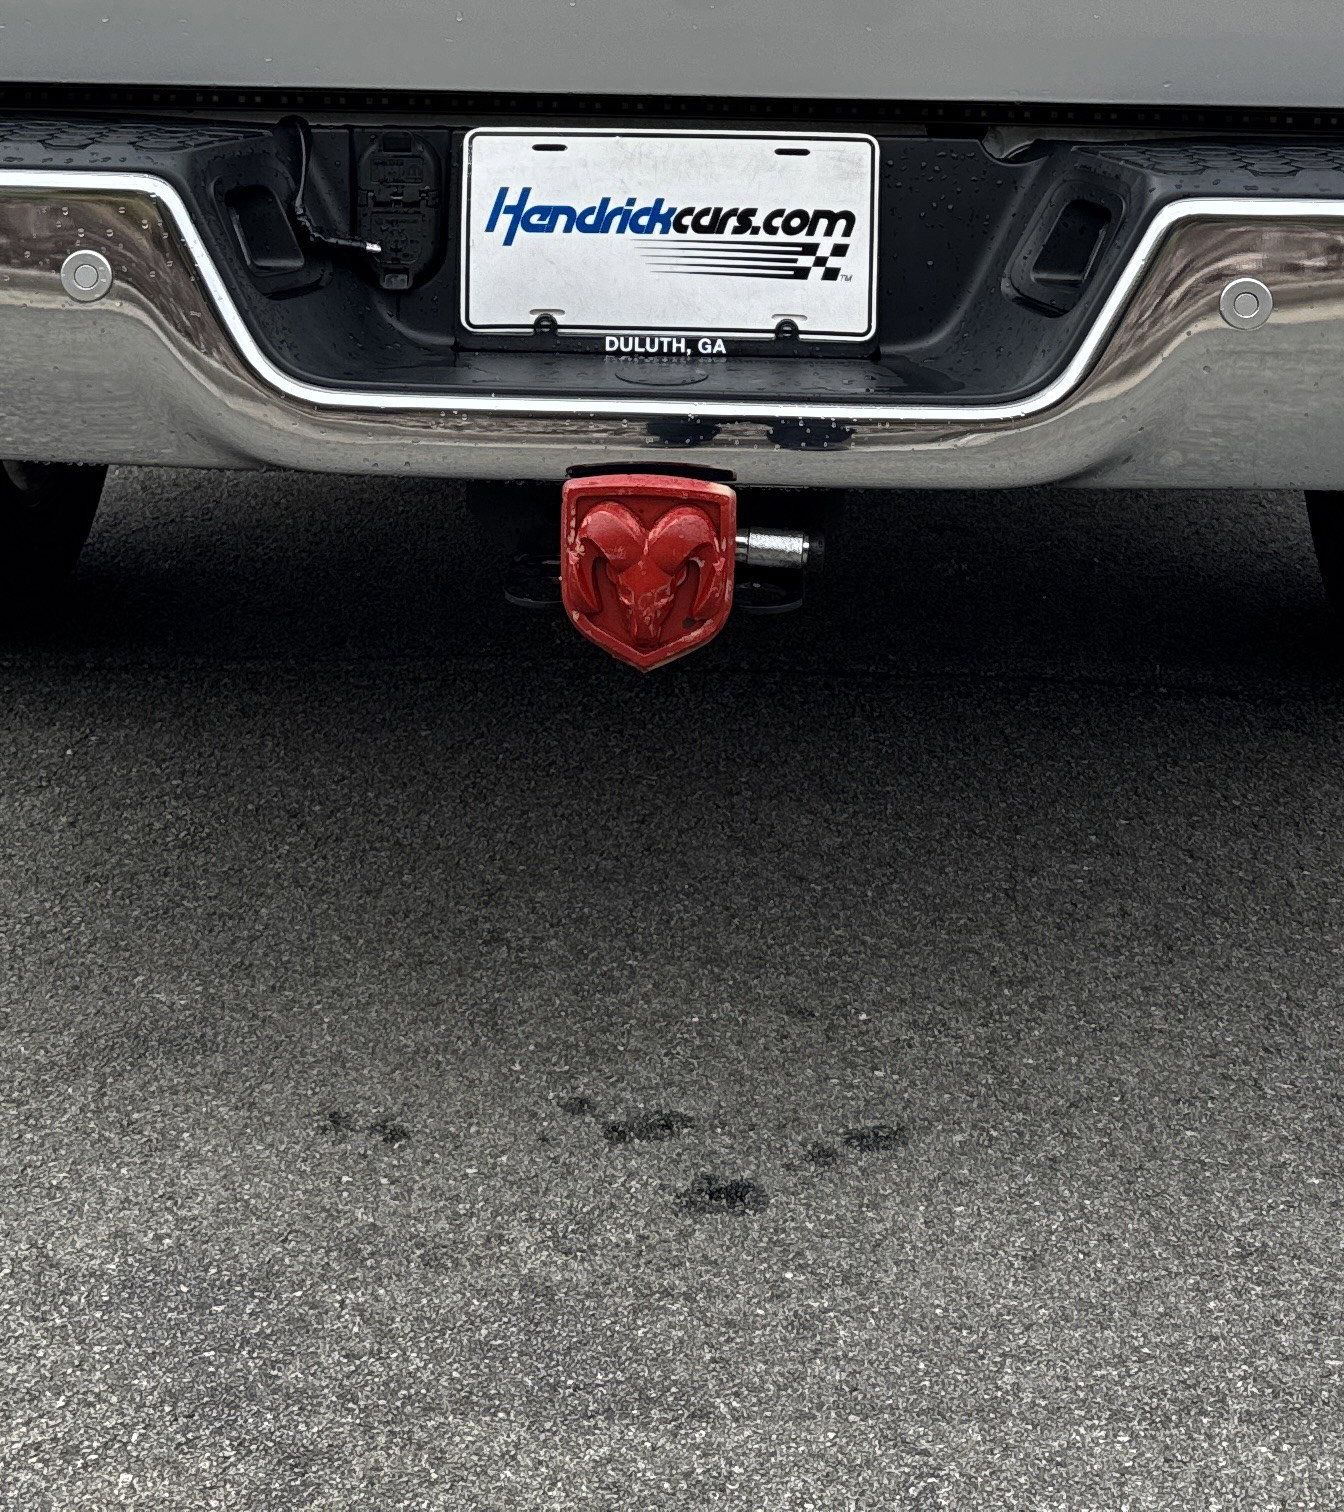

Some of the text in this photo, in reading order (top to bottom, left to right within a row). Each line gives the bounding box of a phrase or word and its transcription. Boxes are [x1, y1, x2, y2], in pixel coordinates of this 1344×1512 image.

[484, 186, 856, 246] Hendrickcars.com
[605, 336, 727, 357] DULUTH, GA
